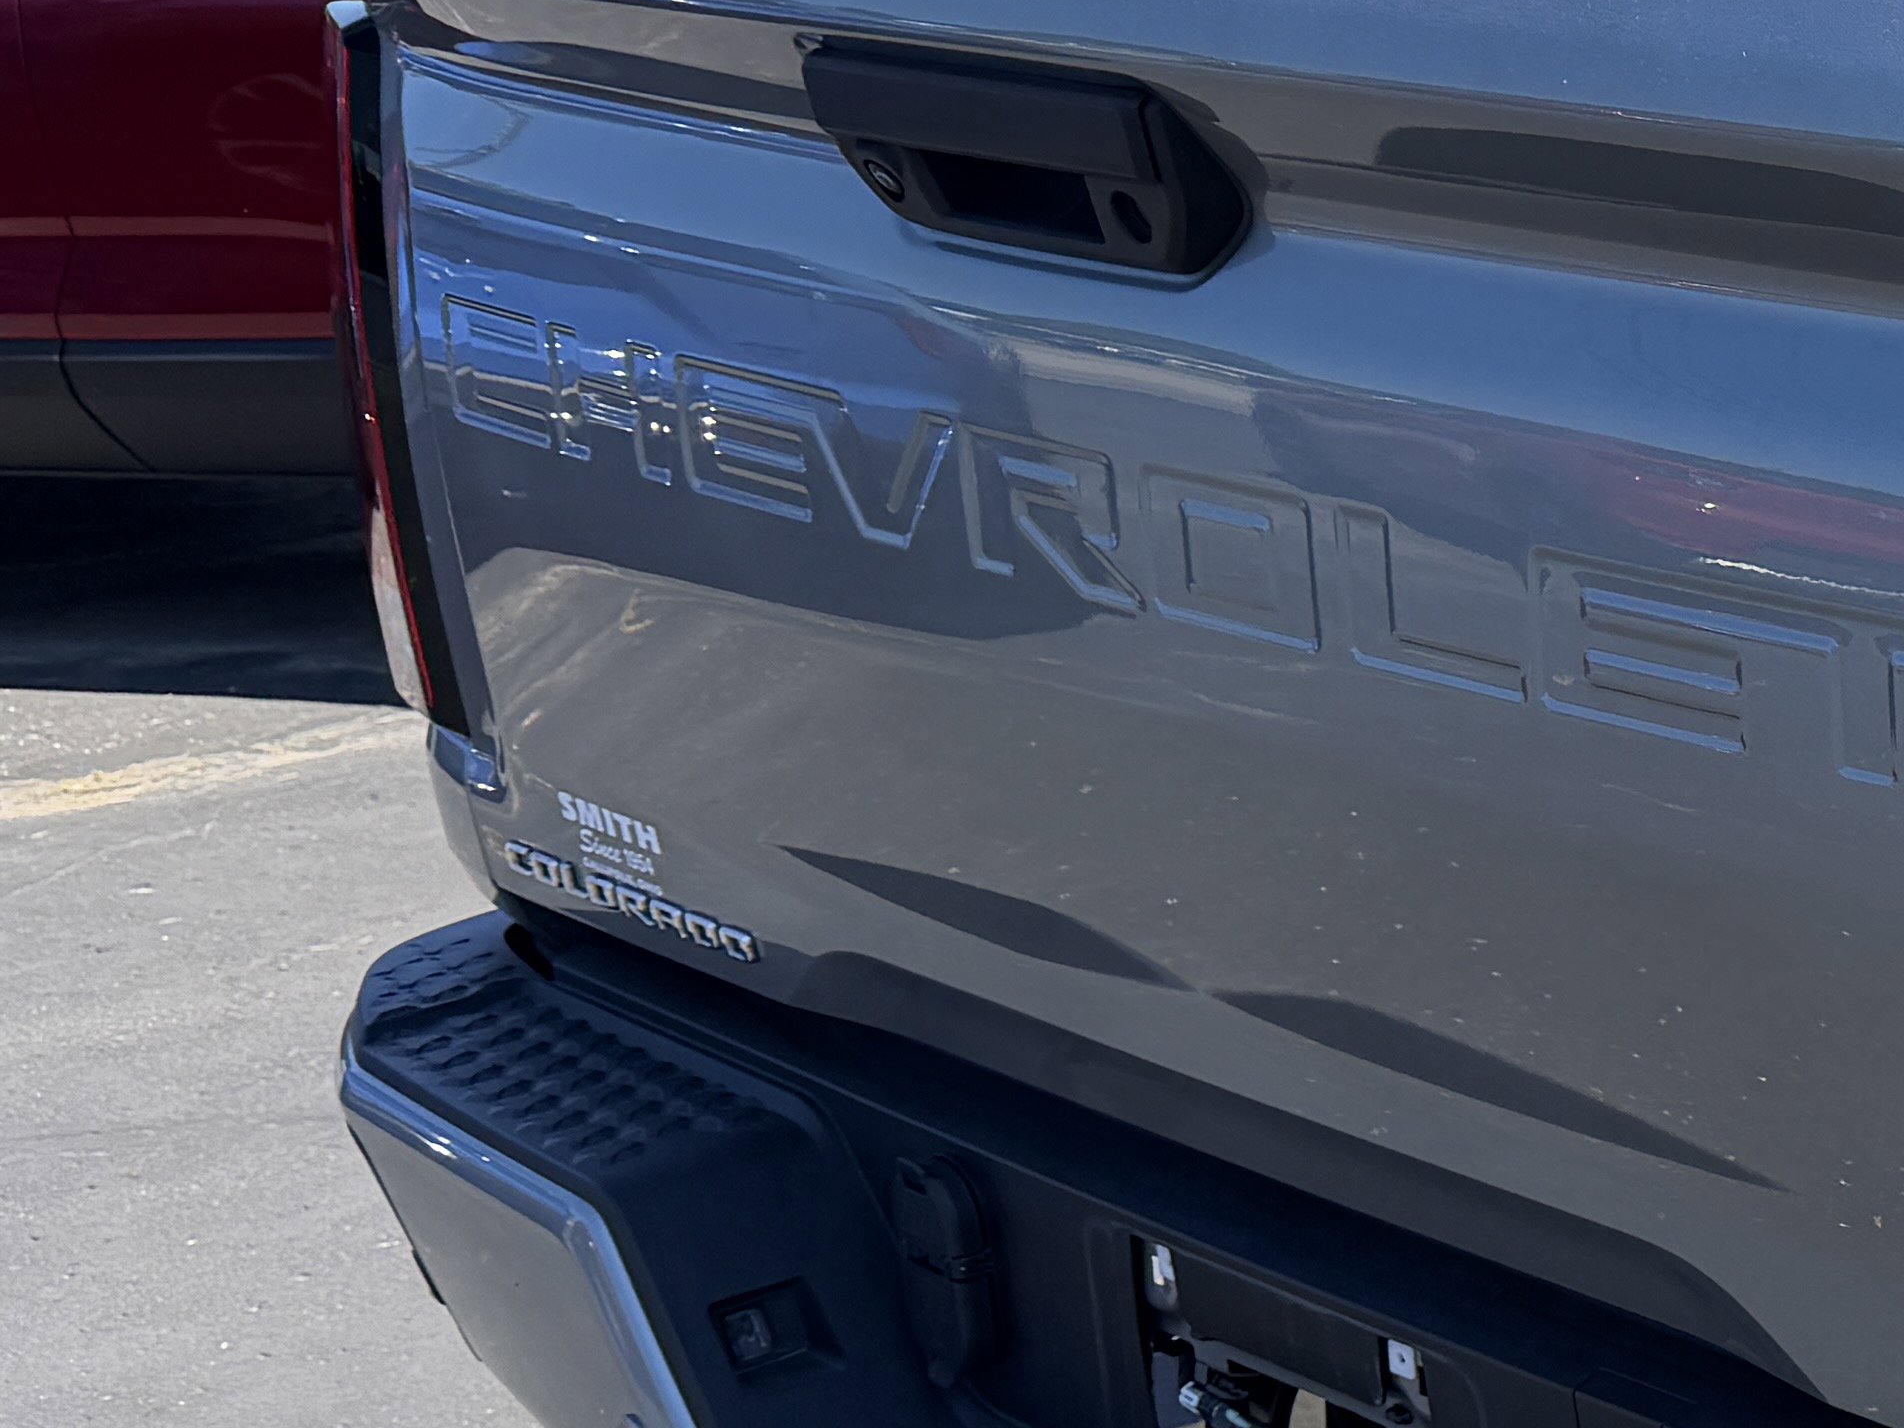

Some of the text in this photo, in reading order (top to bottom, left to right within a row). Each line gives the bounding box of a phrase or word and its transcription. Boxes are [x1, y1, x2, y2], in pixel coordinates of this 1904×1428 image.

[557, 790, 662, 856] SMITH
[579, 828, 623, 864] Since
[503, 839, 762, 964] COLORADO
